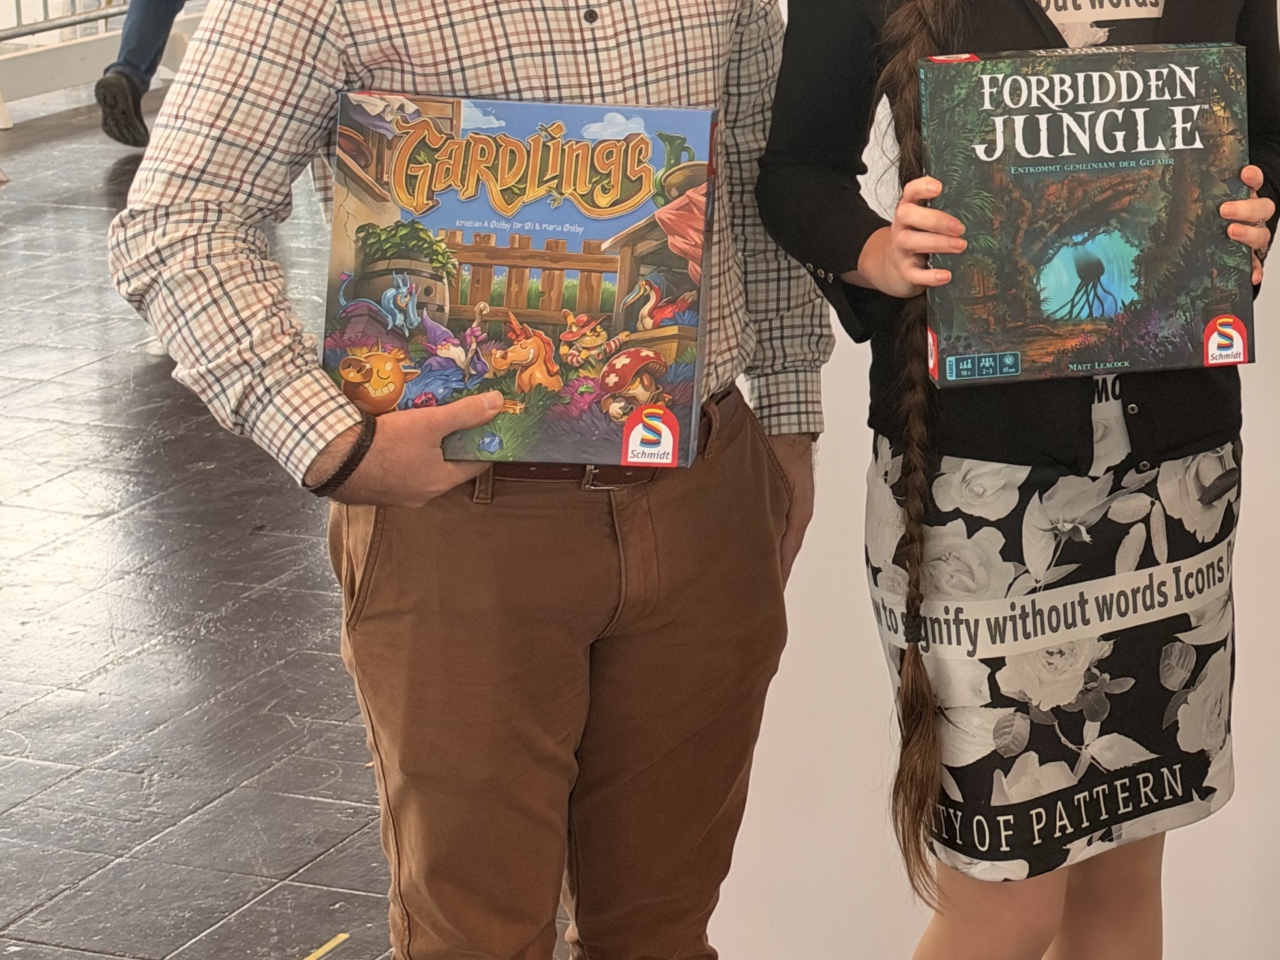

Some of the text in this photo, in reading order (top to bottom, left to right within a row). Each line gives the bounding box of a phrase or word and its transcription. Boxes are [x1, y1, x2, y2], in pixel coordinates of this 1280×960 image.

[978, 63, 1200, 111] FORBIDDEN
[971, 105, 1204, 162] JUNGLE
[542, 223, 562, 231] Maria
[1068, 363, 1091, 372] MATT
[1210, 351, 1242, 362] Schmidt
[629, 449, 670, 460] Schmidt
[986, 591, 1091, 645] without
[1094, 572, 1169, 623] words
[1172, 556, 1225, 602] Icons
[972, 815, 1014, 852] OF
[1030, 764, 1184, 846] PATTERN
